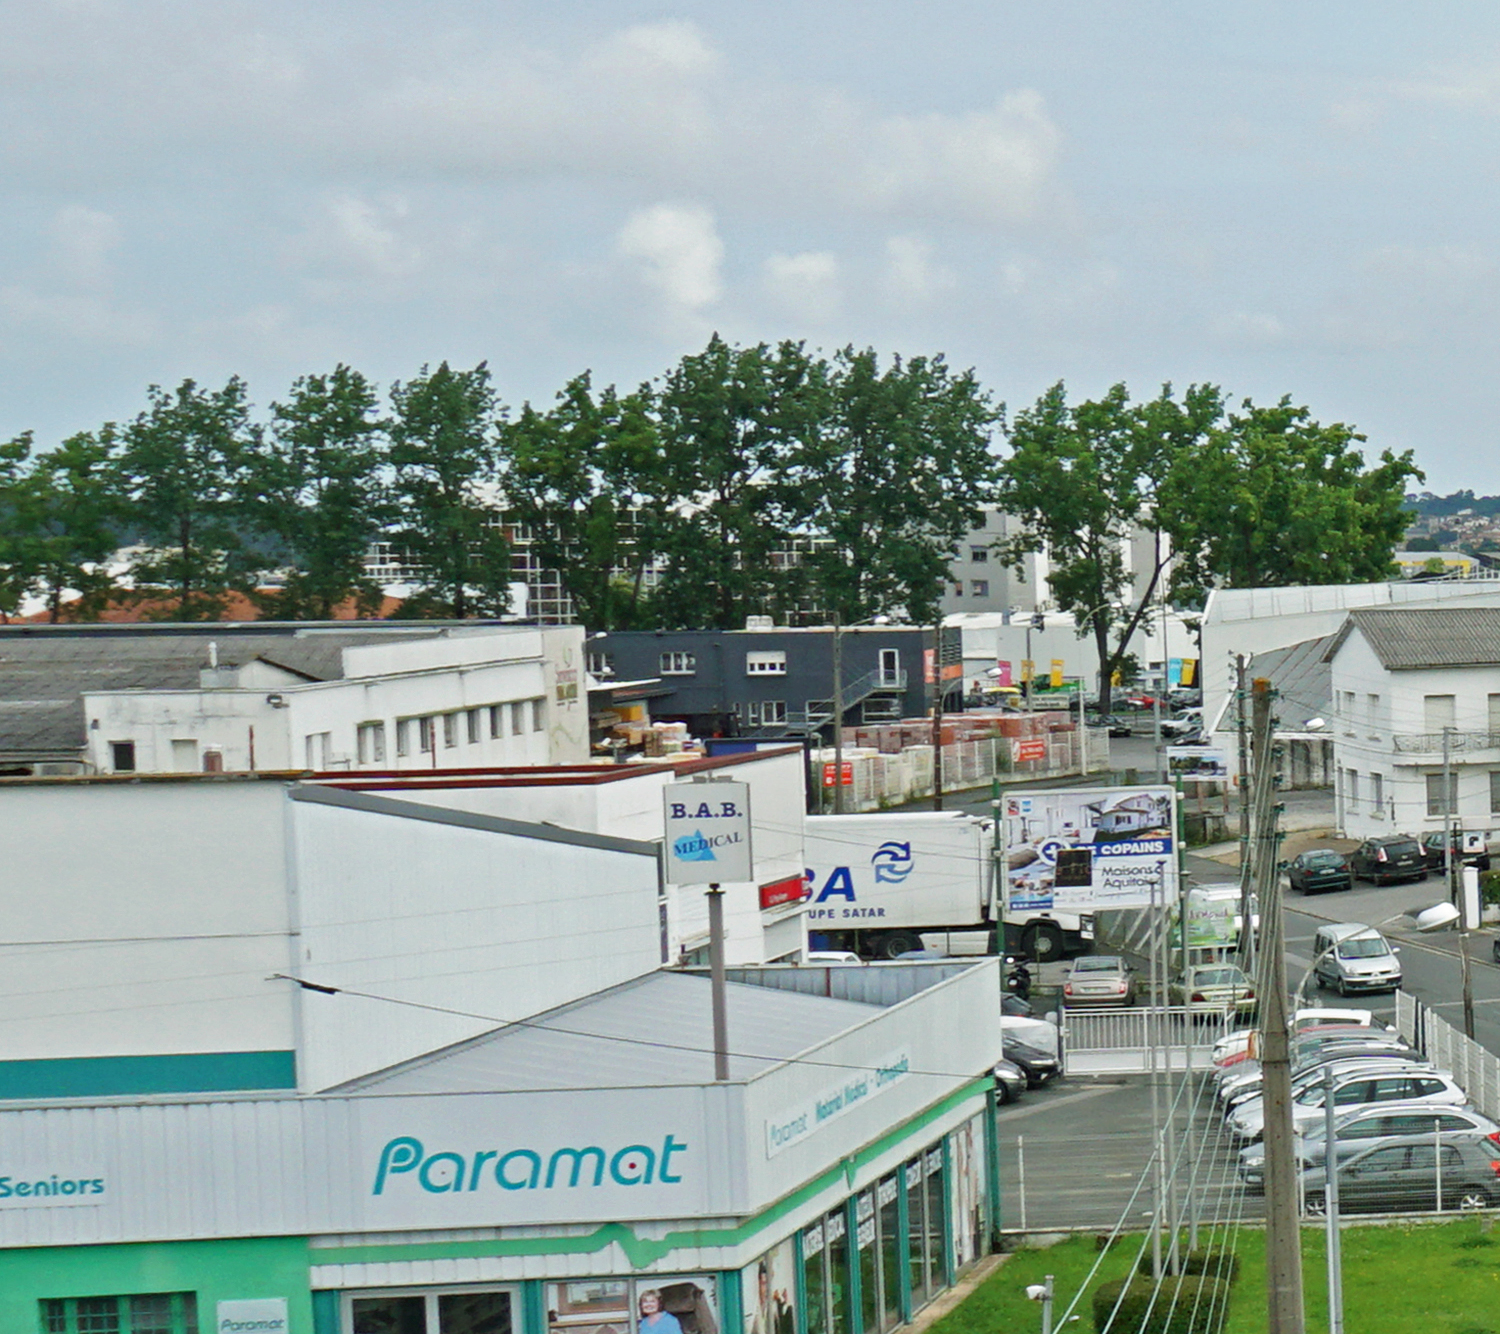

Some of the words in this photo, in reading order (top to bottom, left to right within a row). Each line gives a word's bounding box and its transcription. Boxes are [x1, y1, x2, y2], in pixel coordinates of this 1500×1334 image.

[670, 802, 743, 819] B.A.B.
[674, 831, 743, 856] MEDICAL
[1101, 841, 1164, 855] COPAINS
[1101, 865, 1153, 876] Maisons
[842, 907, 886, 918] SATAR
[372, 1134, 688, 1196] Paramat
[0, 1174, 105, 1198] Seniors
[220, 1318, 285, 1332] Paramat
